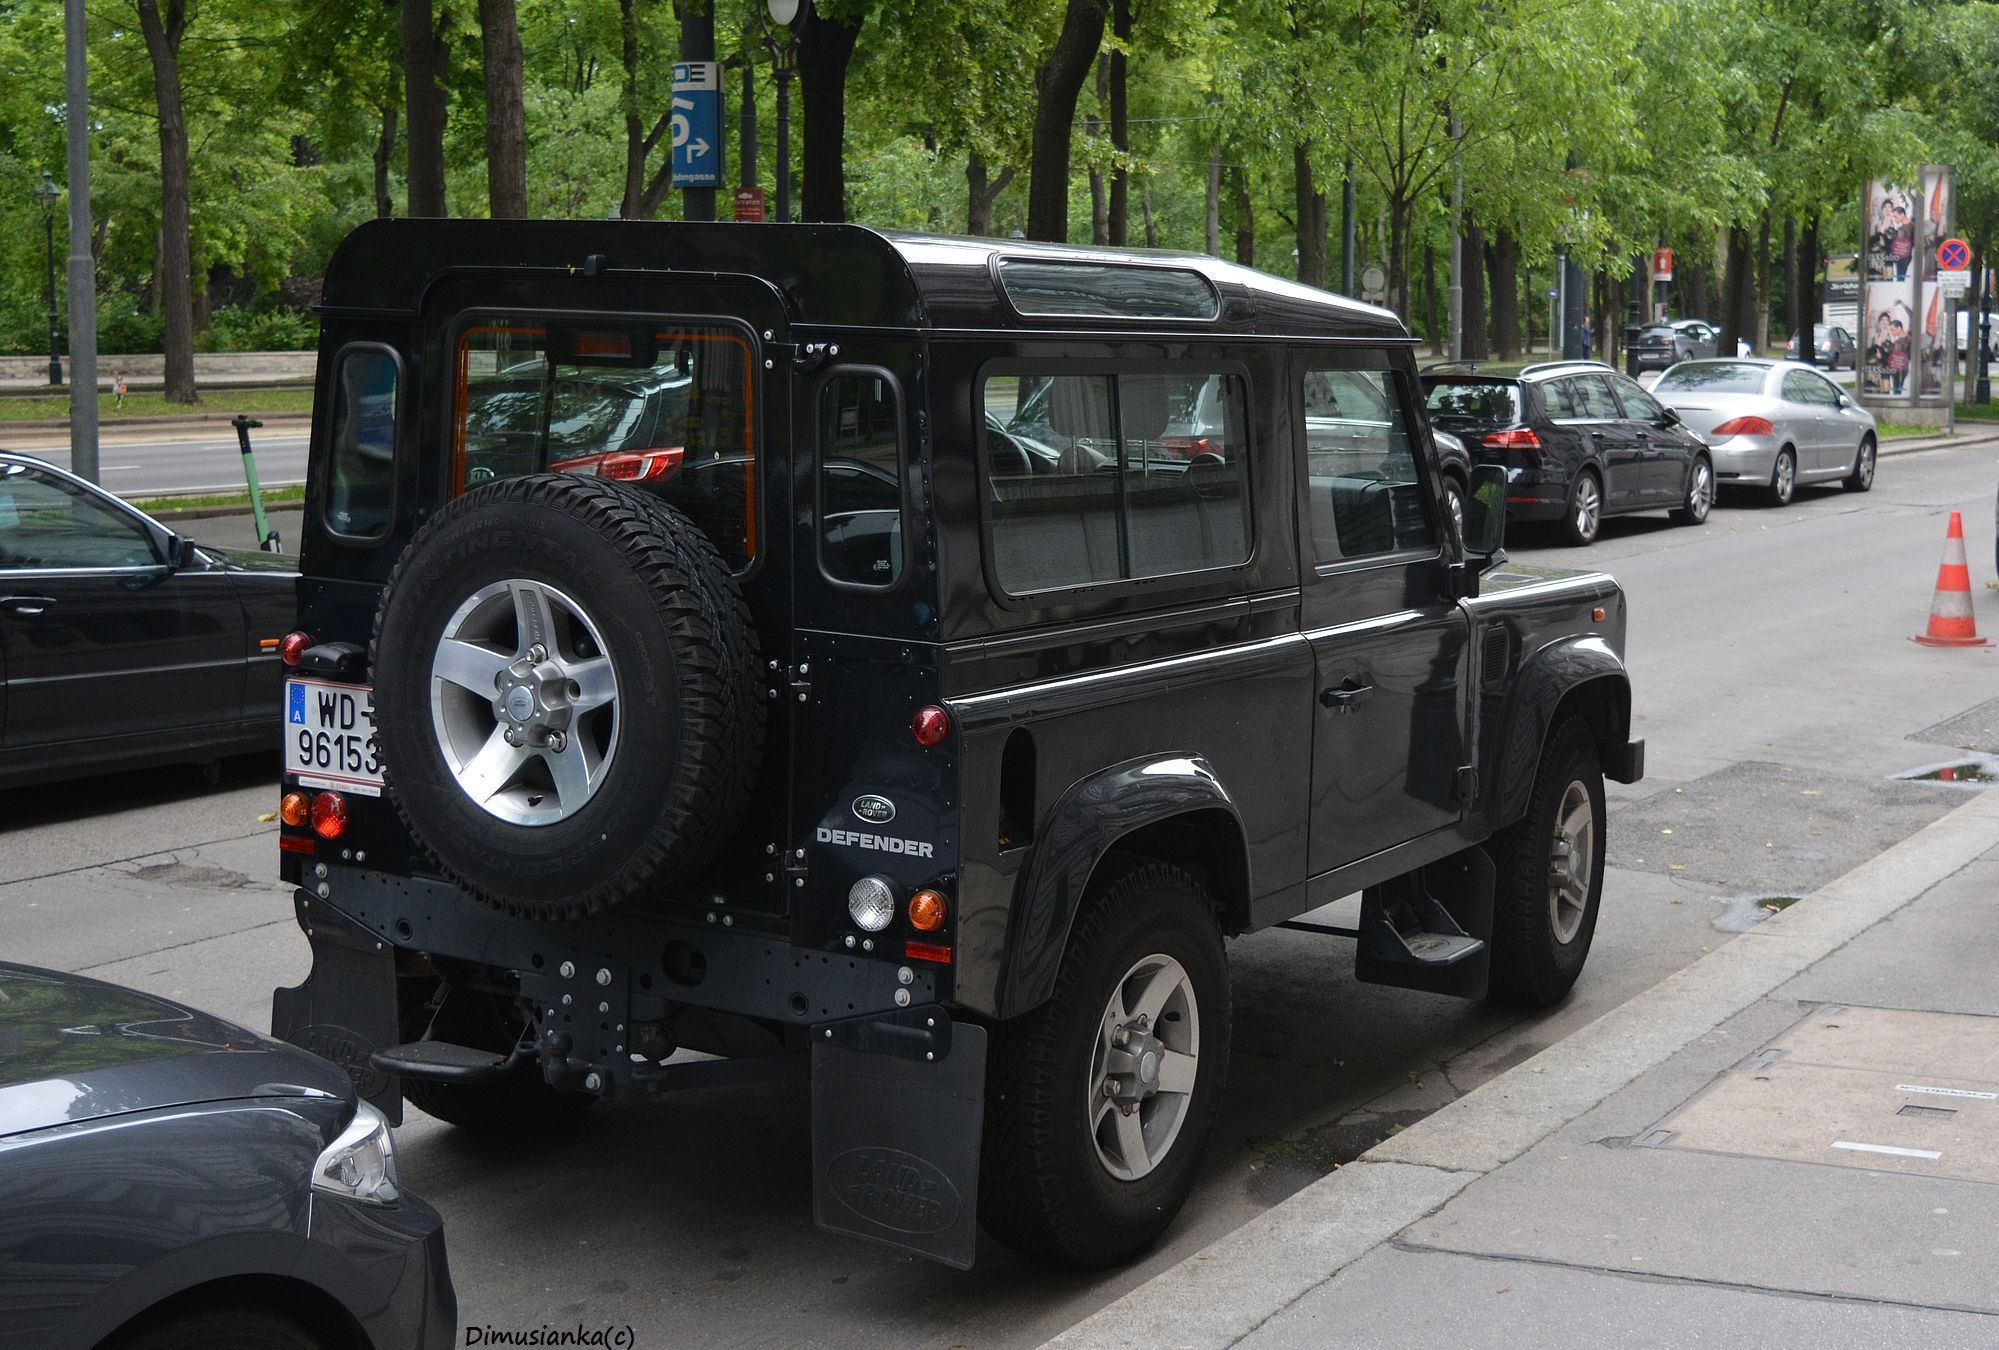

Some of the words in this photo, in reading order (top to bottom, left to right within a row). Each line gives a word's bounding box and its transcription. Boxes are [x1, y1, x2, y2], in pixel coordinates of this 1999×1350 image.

[293, 711, 302, 722] A
[861, 800, 882, 810] LAND
[862, 808, 888, 818] ROVER
[816, 827, 934, 859] DEFENDER
[855, 1155, 919, 1190] LAND
[864, 1182, 944, 1228] ROVER
